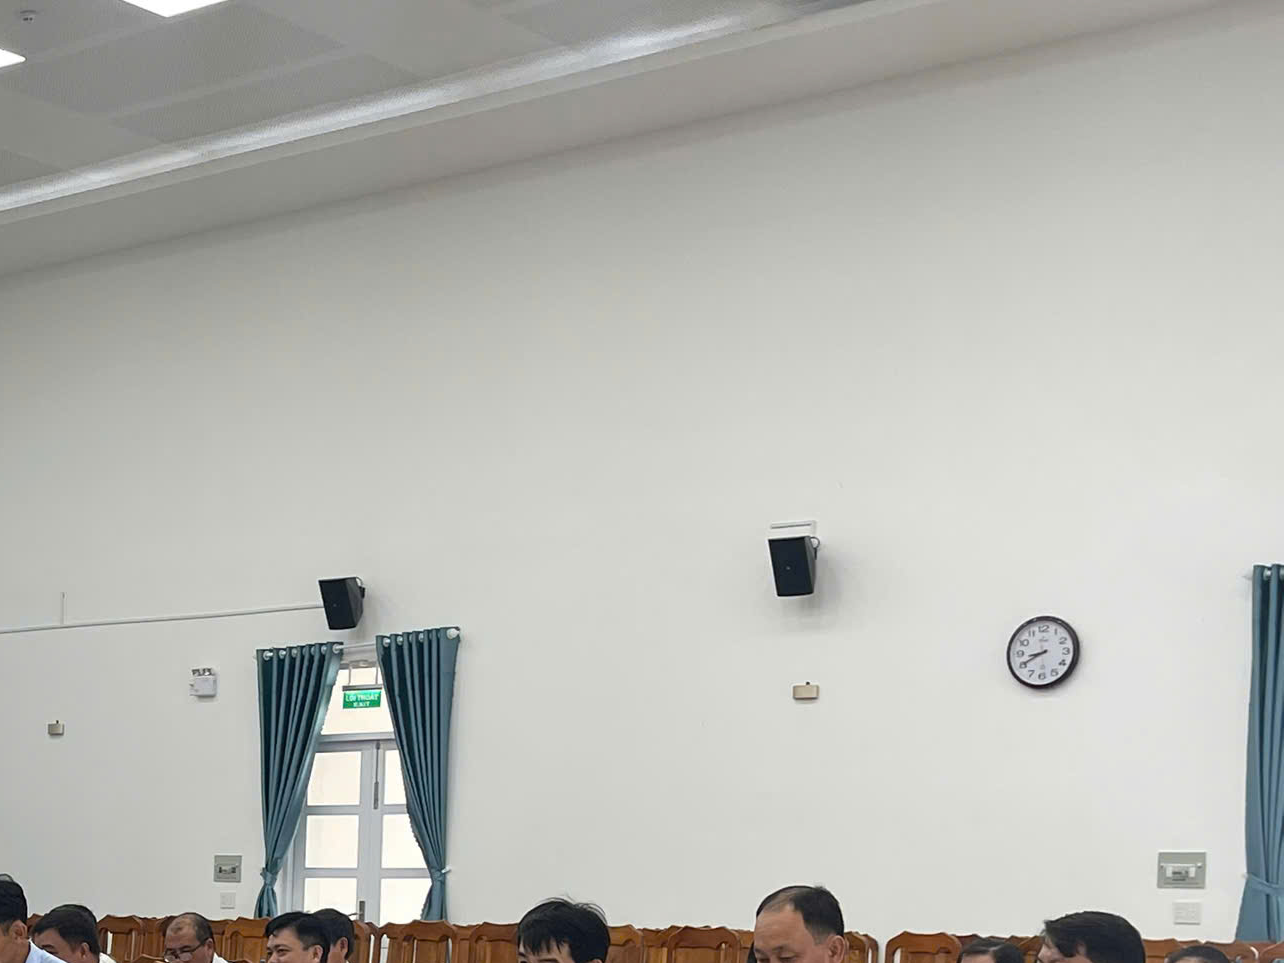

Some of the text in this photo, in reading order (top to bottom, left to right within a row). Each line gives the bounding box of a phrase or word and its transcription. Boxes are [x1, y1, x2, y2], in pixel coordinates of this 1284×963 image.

[1038, 625, 1049, 633] 12
[1019, 639, 1029, 647] 10
[1059, 637, 1067, 645] 2
[1016, 650, 1025, 658] 9
[1062, 647, 1070, 656] 3
[1028, 670, 1035, 678] 7
[1051, 669, 1059, 677] 5
